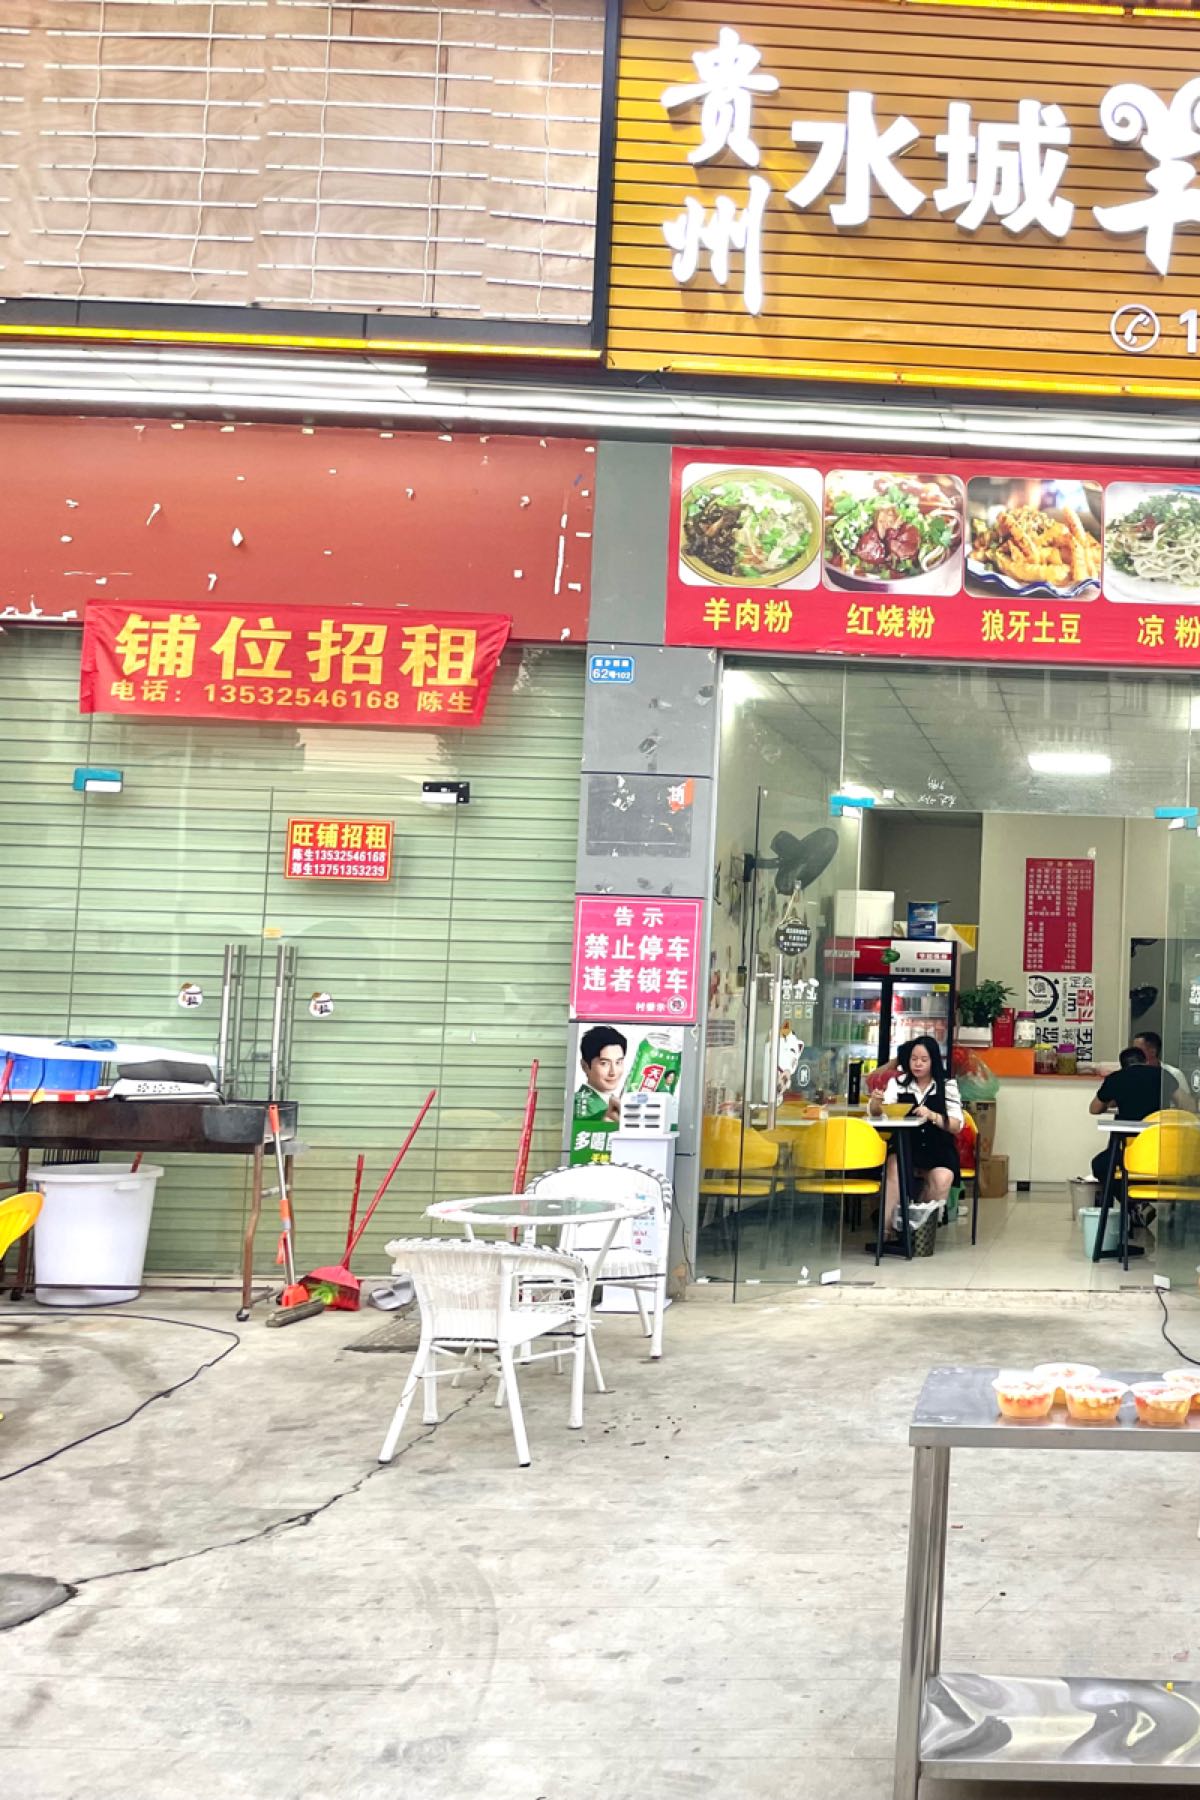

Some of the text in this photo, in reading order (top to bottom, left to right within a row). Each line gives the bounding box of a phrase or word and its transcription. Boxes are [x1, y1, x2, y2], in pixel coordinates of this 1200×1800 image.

[661, 27, 779, 316] 贵州
[703, 597, 793, 633] 羊肉粉
[846, 603, 936, 638] 红烧粉
[981, 609, 1082, 645] 狼牙土豆
[115, 613, 479, 688] 铺位招租
[204, 683, 399, 710] 13532546168
[417, 691, 474, 714] 陈生
[293, 823, 387, 849] 旺铺招租
[614, 905, 664, 928] 告示
[584, 933, 690, 962] 禁止停车
[582, 965, 688, 994] 违者锁车
